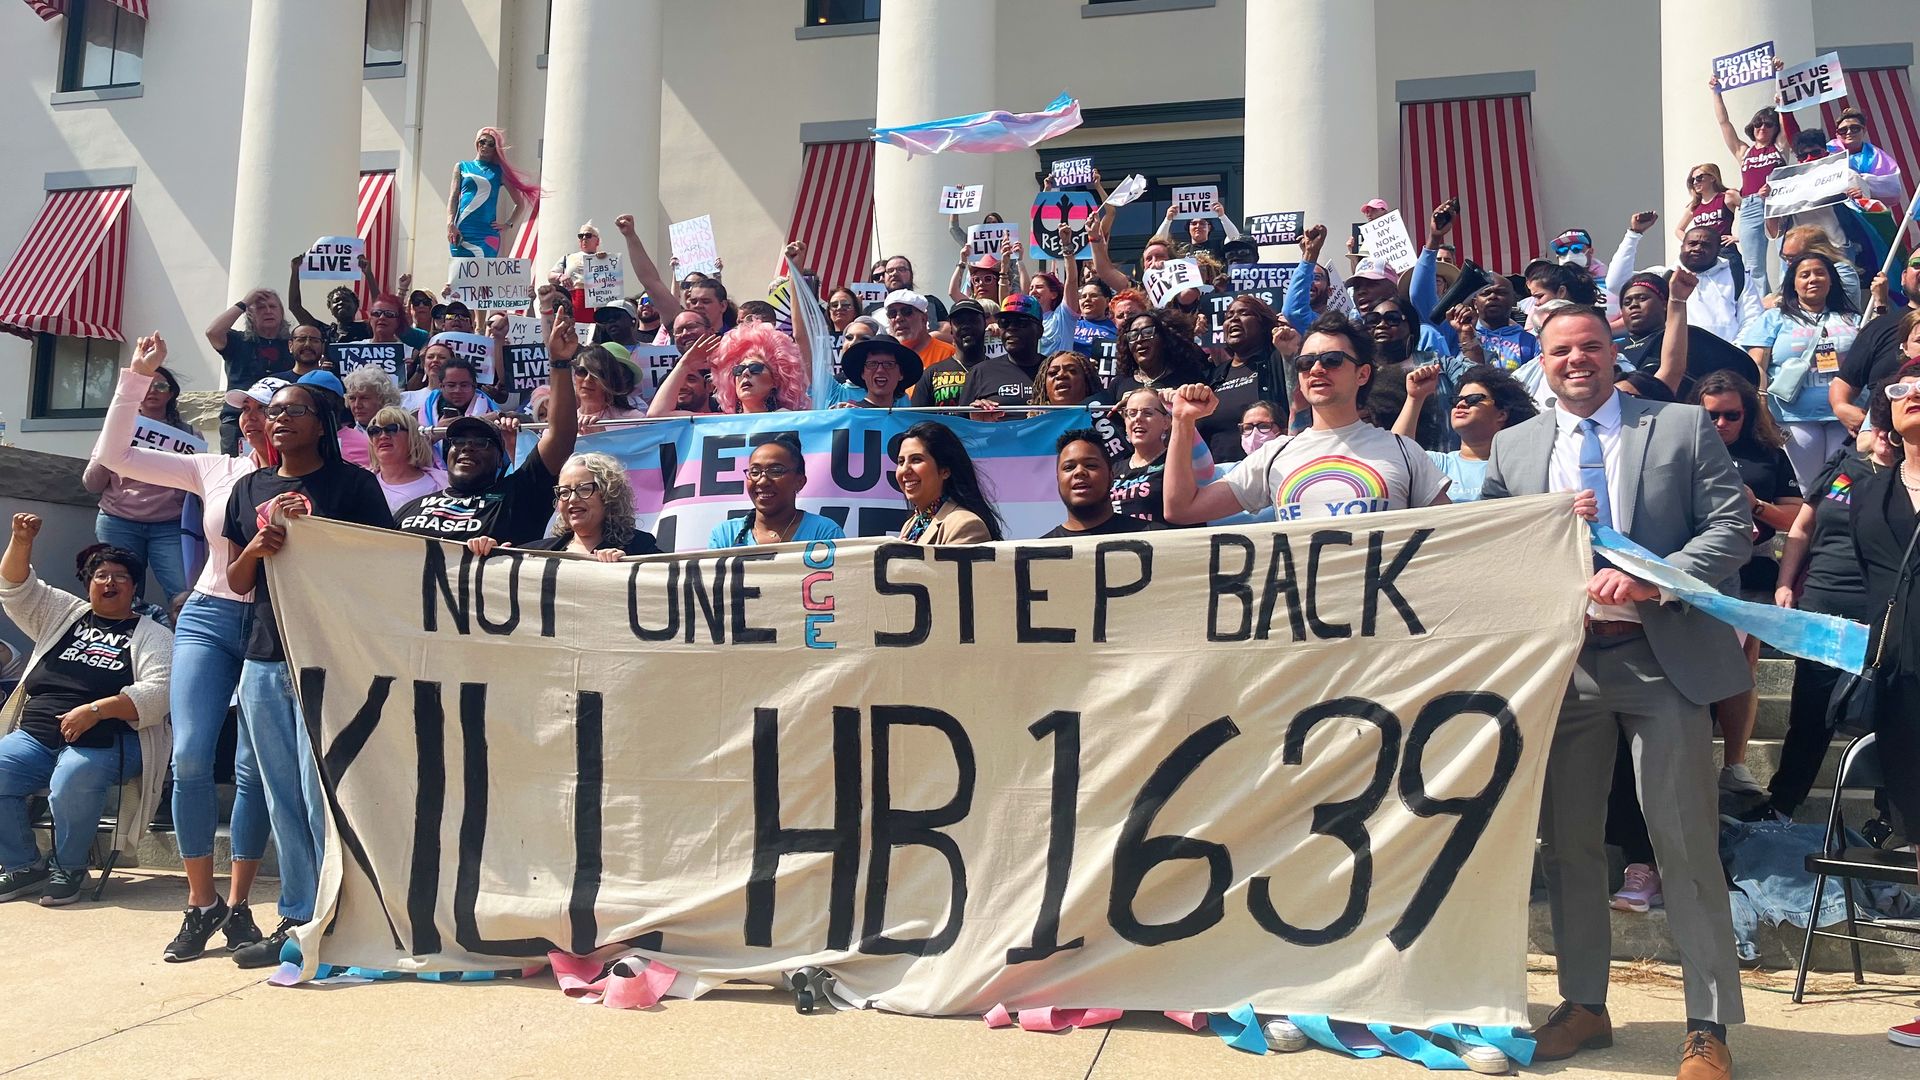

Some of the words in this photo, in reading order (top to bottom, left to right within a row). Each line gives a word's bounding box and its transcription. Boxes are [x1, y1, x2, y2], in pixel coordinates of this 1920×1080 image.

[1716, 45, 1770, 69] PROTECT
[1717, 55, 1772, 79] TRANS
[1718, 65, 1773, 89] YOUTH
[1779, 71, 1804, 90] LET
[1809, 64, 1829, 78] US
[1781, 76, 1833, 106] LIVE
[1054, 158, 1092, 170] PROTECT
[1054, 165, 1092, 178] TRANS
[1054, 173, 1092, 186] YOUTH
[947, 191, 963, 199] LET
[965, 190, 976, 198] US
[1178, 193, 1196, 201] LET
[1198, 192, 1211, 200] US
[946, 197, 974, 209] LIVE
[1179, 200, 1211, 214] LIVE
[672, 216, 710, 235] TRANS
[1252, 213, 1297, 224] TRANS
[1372, 214, 1398, 231] LOVE
[974, 230, 991, 240] LET
[1251, 222, 1297, 235] LIVES
[1377, 226, 1391, 238] MY
[672, 230, 711, 249] RIGHTS
[1042, 232, 1089, 256] RESST
[1251, 232, 1296, 244] MATTER
[1375, 234, 1400, 249] NON-
[309, 244, 331, 254] LET
[335, 244, 352, 254] US
[974, 239, 1004, 254] LIV
[1373, 239, 1407, 258] BINARY
[308, 255, 352, 272] LIVE
[1385, 249, 1408, 264] HILD
[458, 260, 479, 279] NO
[487, 260, 521, 277] MORE
[1147, 270, 1165, 288] LET
[1169, 263, 1187, 273] US
[1231, 267, 1295, 280] PROTECT
[593, 272, 617, 288] Rights
[1152, 270, 1190, 304] LIVE
[458, 285, 494, 302] TRANS
[588, 288, 612, 297] Human
[858, 290, 880, 301] LET
[1210, 292, 1273, 313] TRS
[512, 323, 527, 334] MY
[338, 347, 396, 359] TRANS
[467, 343, 487, 356] US
[511, 347, 549, 361] TRA
[339, 359, 397, 374] LES
[650, 354, 679, 368] LET
[512, 361, 550, 378] LIVE
[514, 376, 549, 390] MATT
[134, 426, 170, 447] LET
[173, 440, 196, 455] US
[401, 515, 482, 532] ERASED
[422, 537, 561, 638] NOT
[627, 552, 778, 645] ONE
[873, 540, 1154, 648] STEP
[1206, 527, 1436, 643] BACK
[73, 623, 132, 649] WON'T
[58, 647, 125, 671] ERASED
[300, 666, 663, 957] KILL
[744, 704, 977, 957] HB
[1004, 690, 1525, 964] 1639
